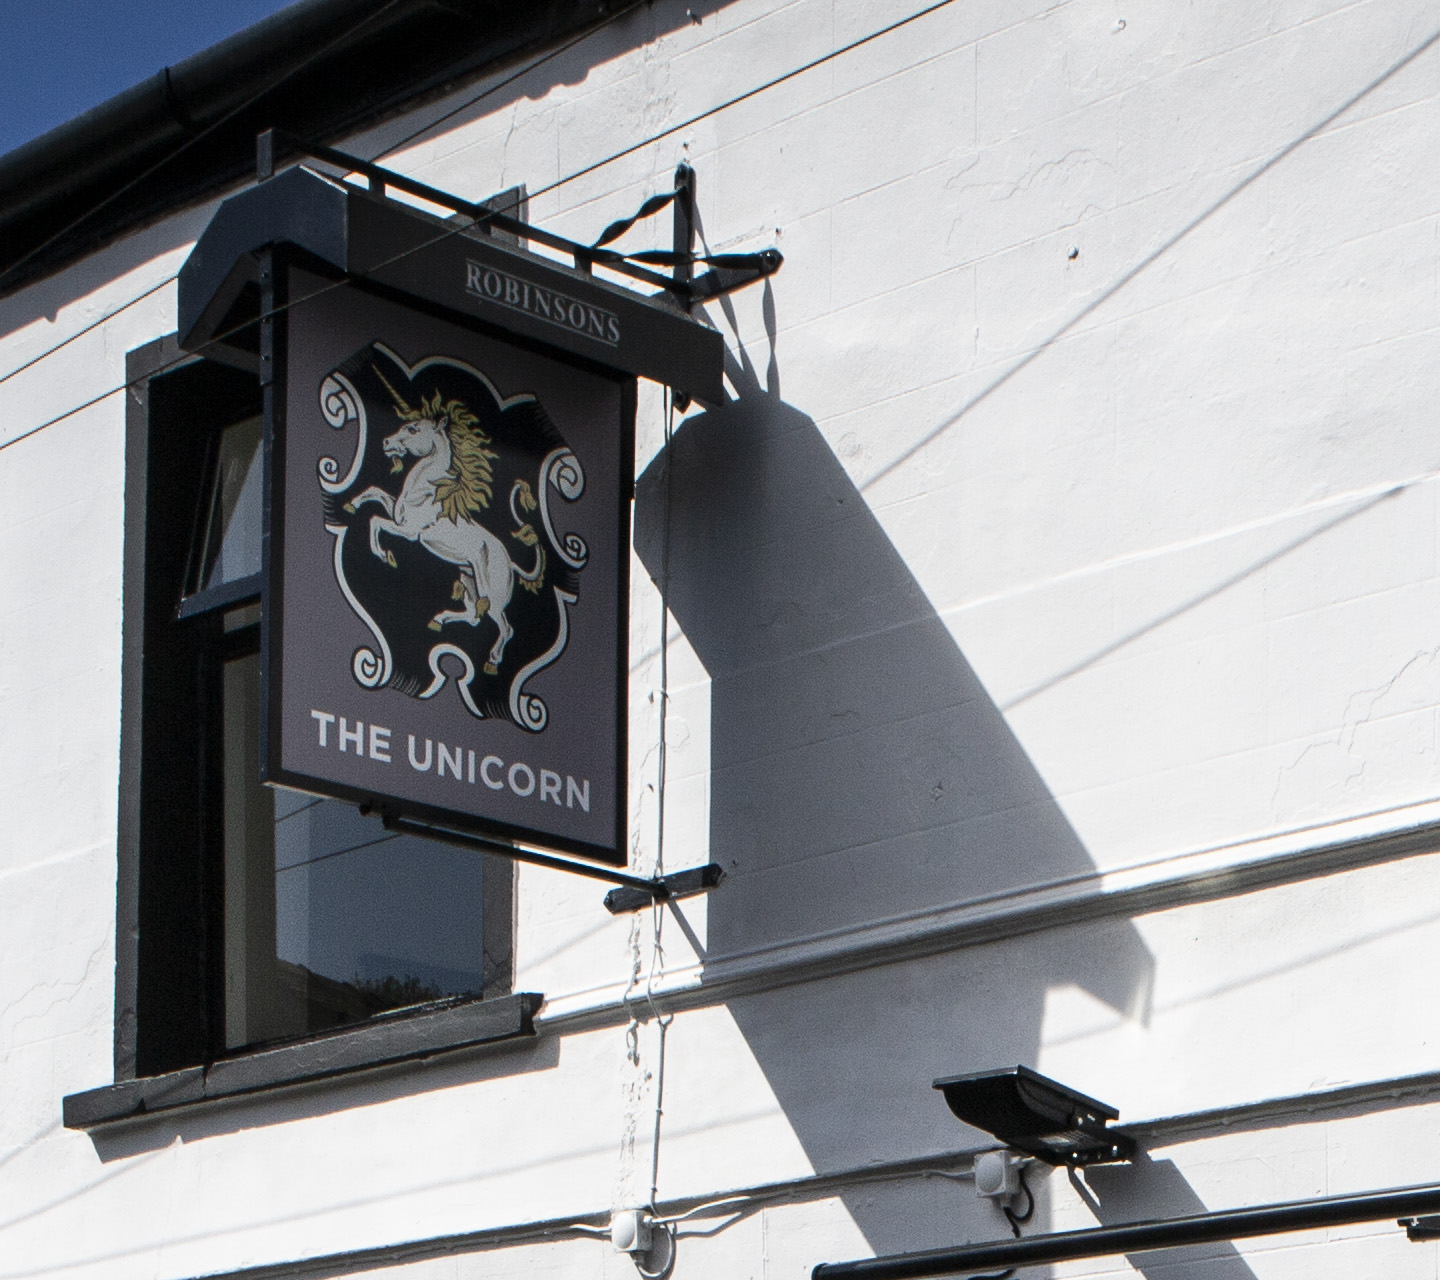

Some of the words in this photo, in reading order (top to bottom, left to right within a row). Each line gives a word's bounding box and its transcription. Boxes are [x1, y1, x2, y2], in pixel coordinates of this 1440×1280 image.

[466, 262, 621, 343] ROBINSONS
[310, 709, 392, 764] THE
[407, 734, 591, 813] UNICORN
